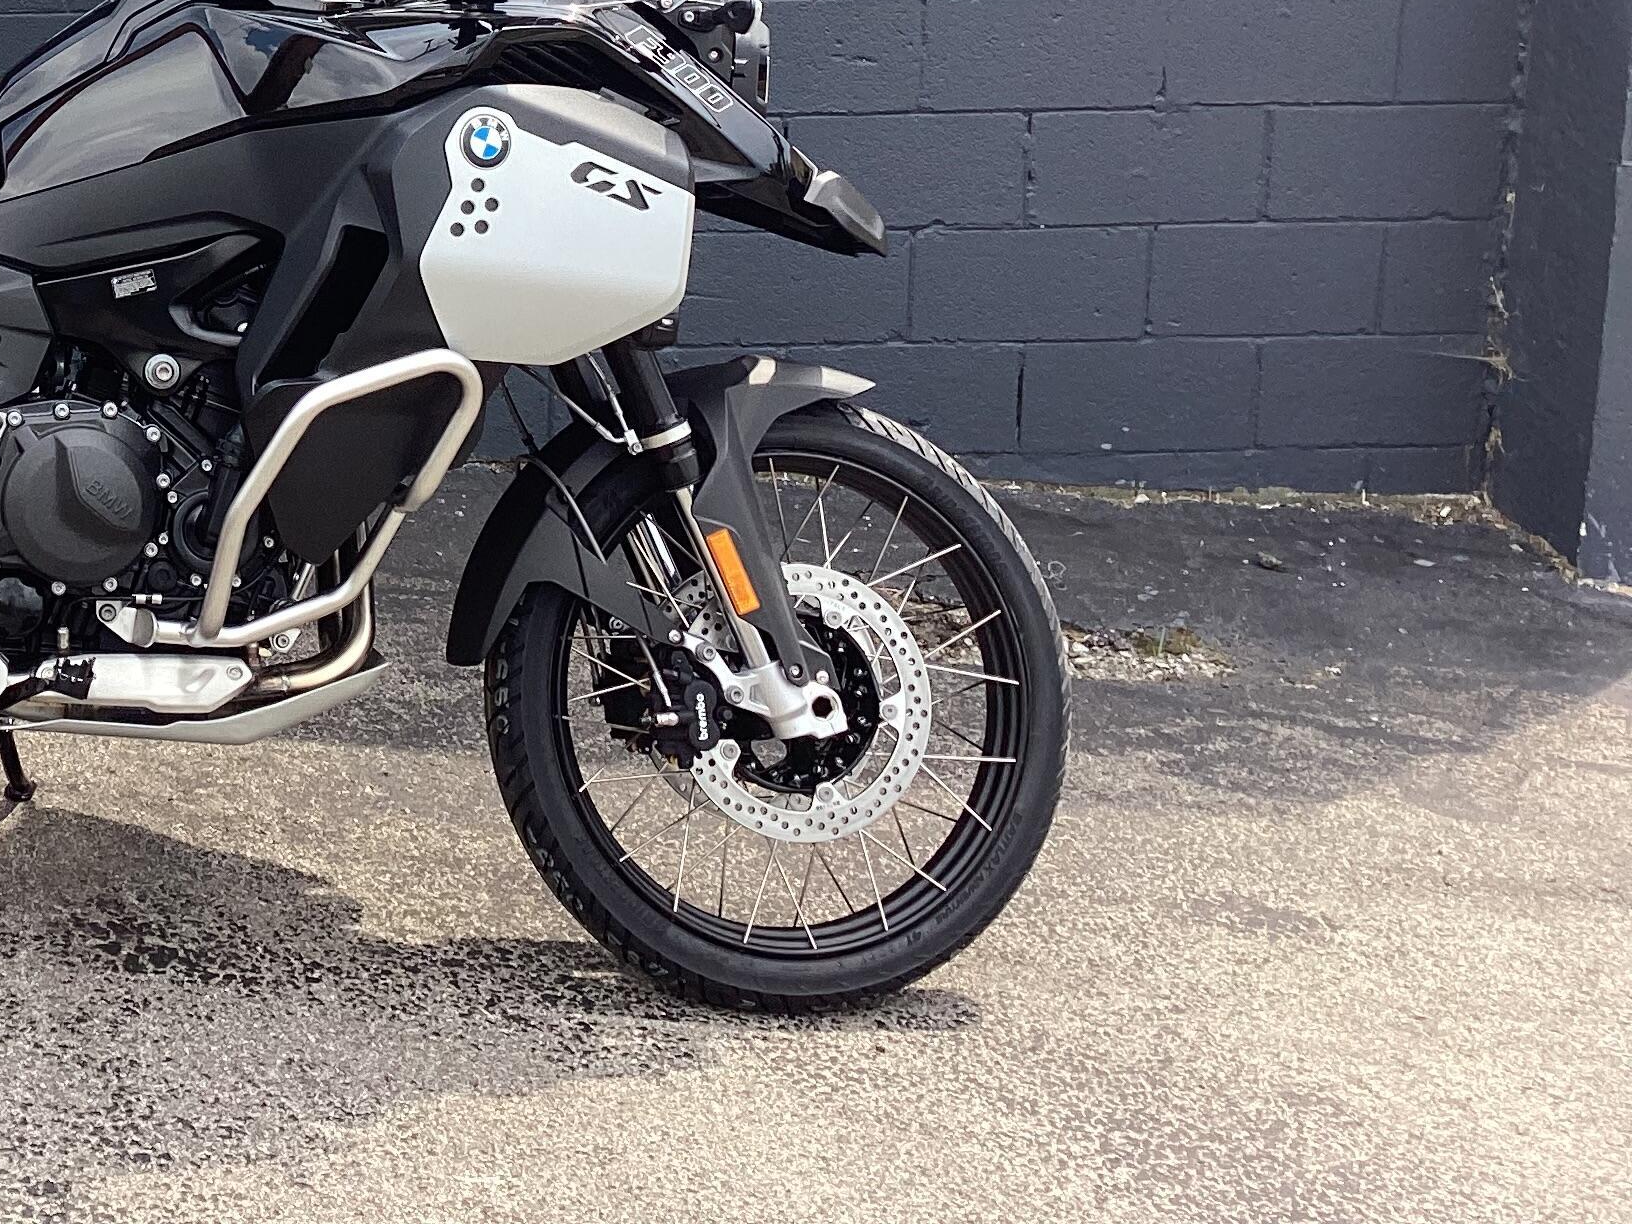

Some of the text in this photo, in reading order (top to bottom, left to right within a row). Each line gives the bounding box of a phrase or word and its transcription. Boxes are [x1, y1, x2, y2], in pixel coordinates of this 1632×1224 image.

[570, 161, 662, 211] GS
[85, 480, 133, 520] BMW
[695, 692, 709, 740] brembo
